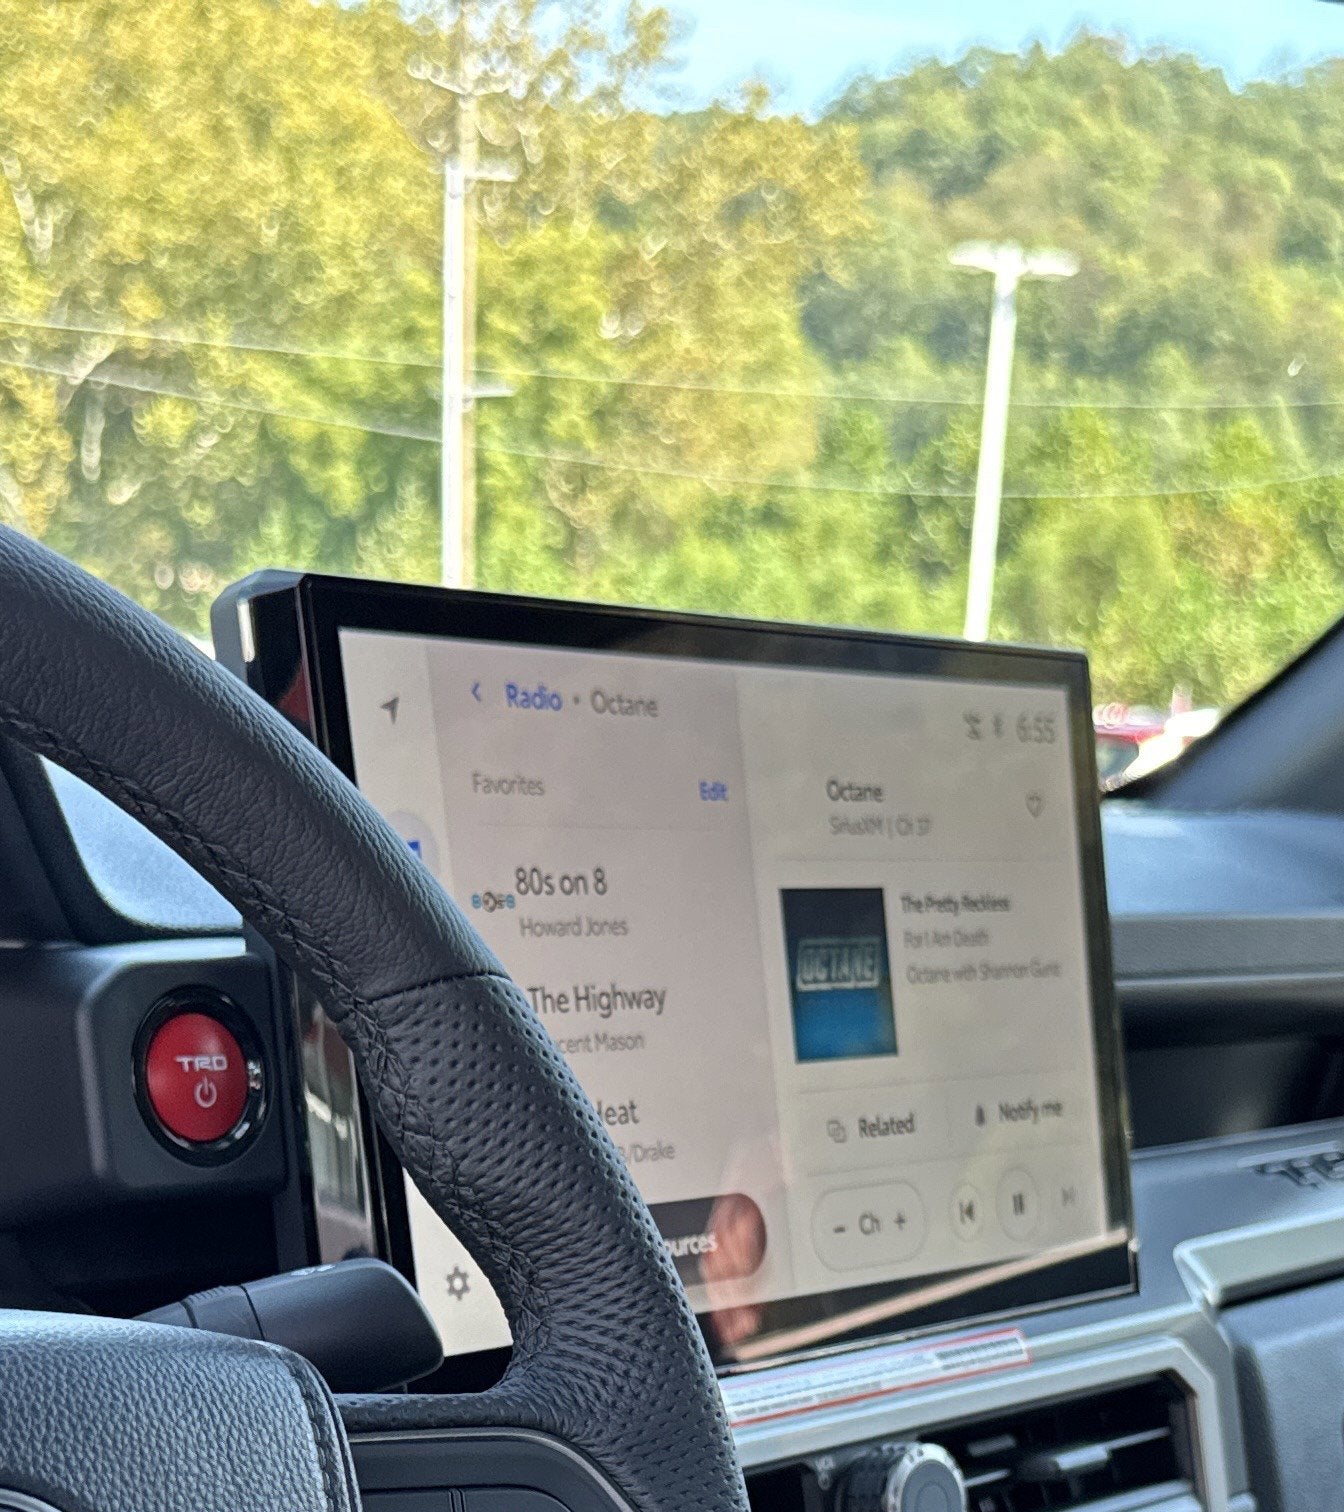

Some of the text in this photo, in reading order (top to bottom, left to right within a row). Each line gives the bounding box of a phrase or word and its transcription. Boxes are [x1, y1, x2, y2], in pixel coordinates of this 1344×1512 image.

[506, 681, 658, 717] Radio Octane
[471, 770, 545, 796] Favorites
[699, 780, 729, 801] Edit
[826, 777, 883, 802] Octane
[515, 866, 607, 896] 80s on 8
[519, 915, 629, 937] Howard Jones
[527, 983, 666, 1019] The Highway
[558, 1032, 645, 1054] cent Mason
[175, 1054, 229, 1072] TRD
[998, 1100, 1064, 1124] Notify me
[858, 1113, 916, 1138] Related
[859, 1212, 882, 1235] Ch
